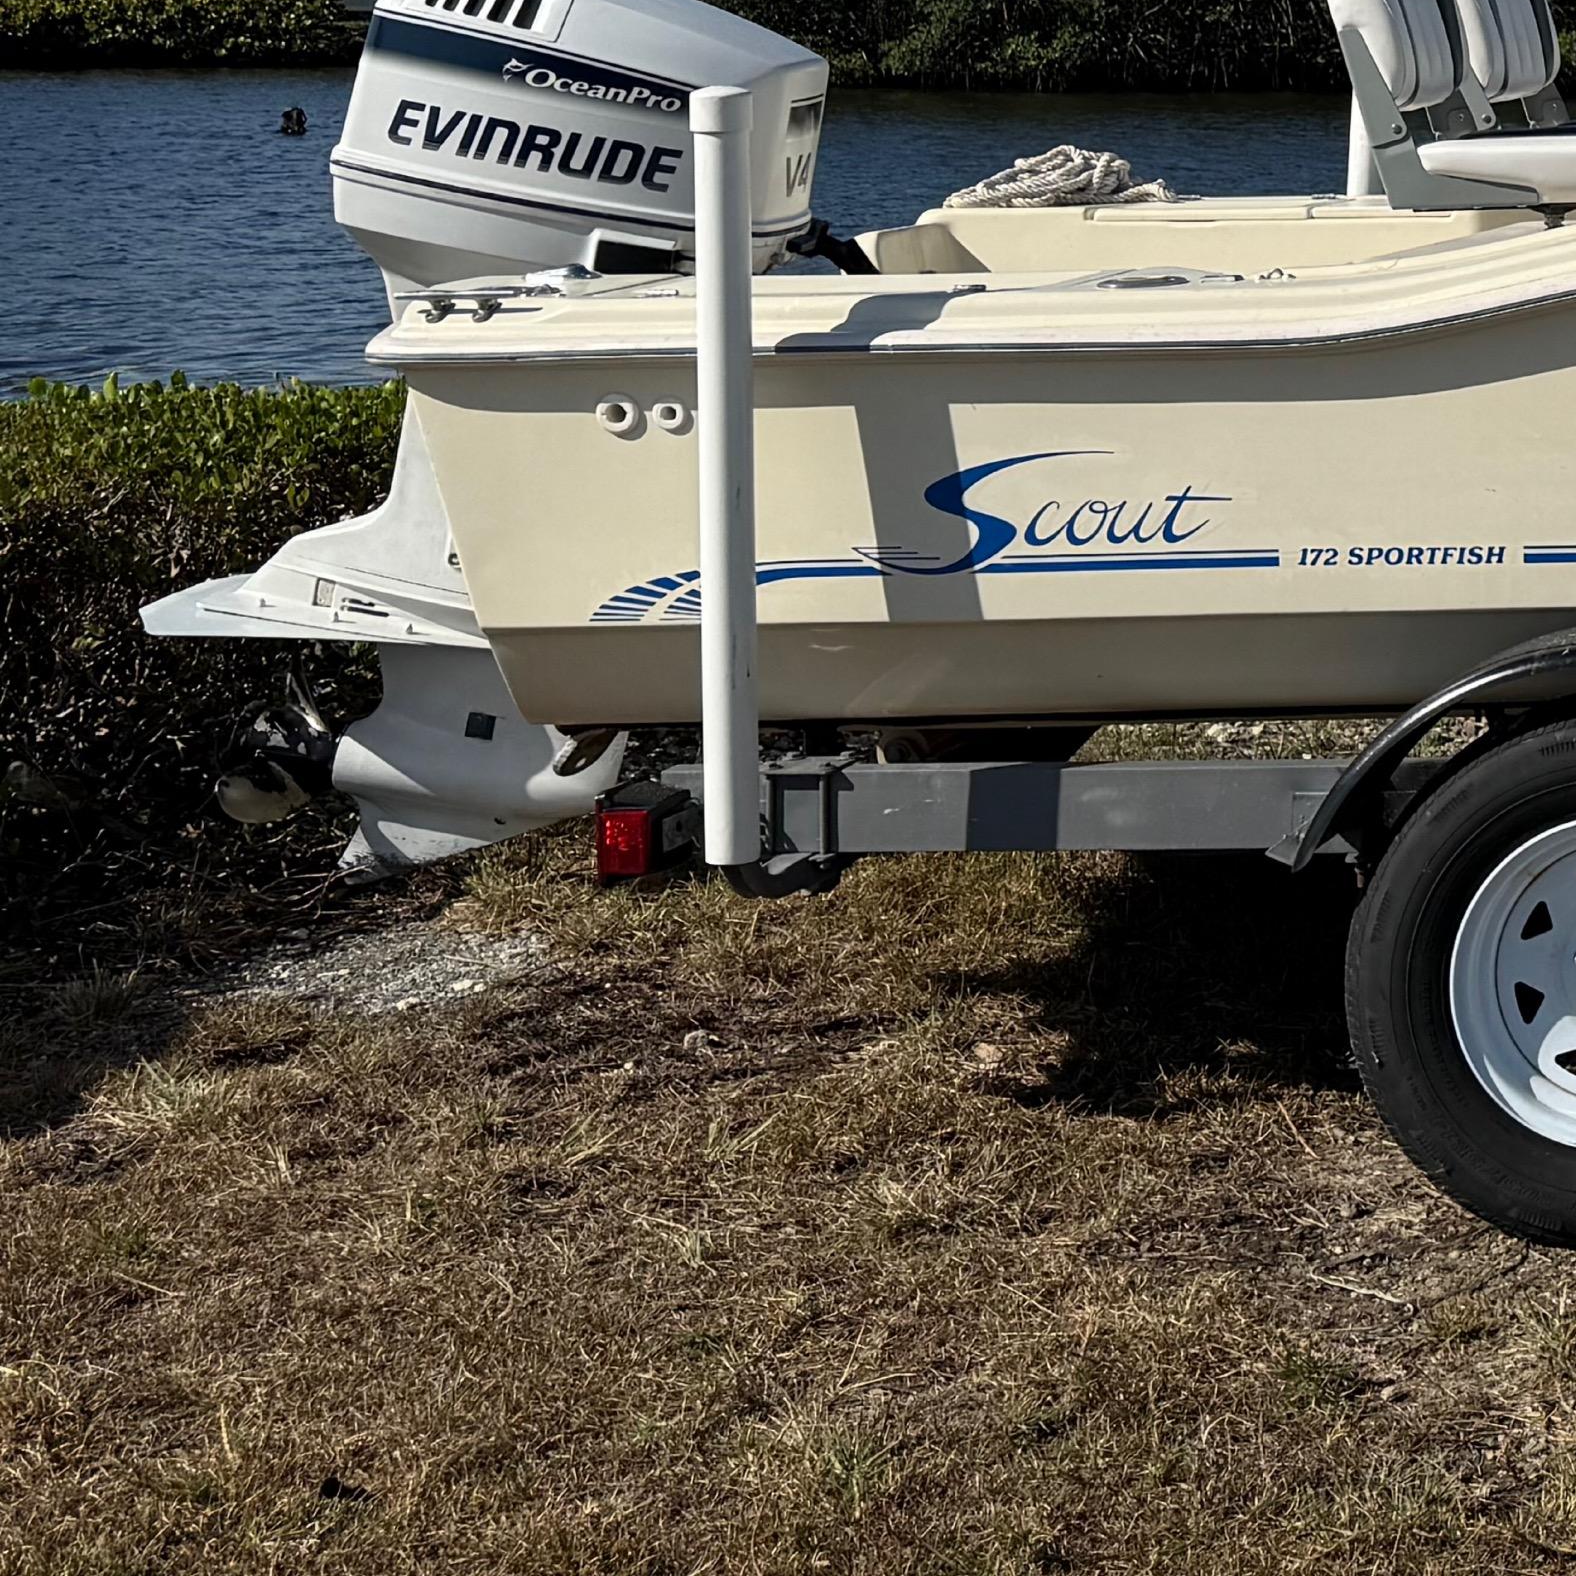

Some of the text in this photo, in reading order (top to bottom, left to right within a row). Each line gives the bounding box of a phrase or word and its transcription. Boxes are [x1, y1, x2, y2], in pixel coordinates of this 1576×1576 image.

[524, 68, 681, 112] OceanPro
[387, 99, 683, 193] EVINRUDE
[786, 152, 812, 197] V4
[852, 450, 1232, 576] Scout
[1297, 544, 1506, 567] 172 SPORTFISH
